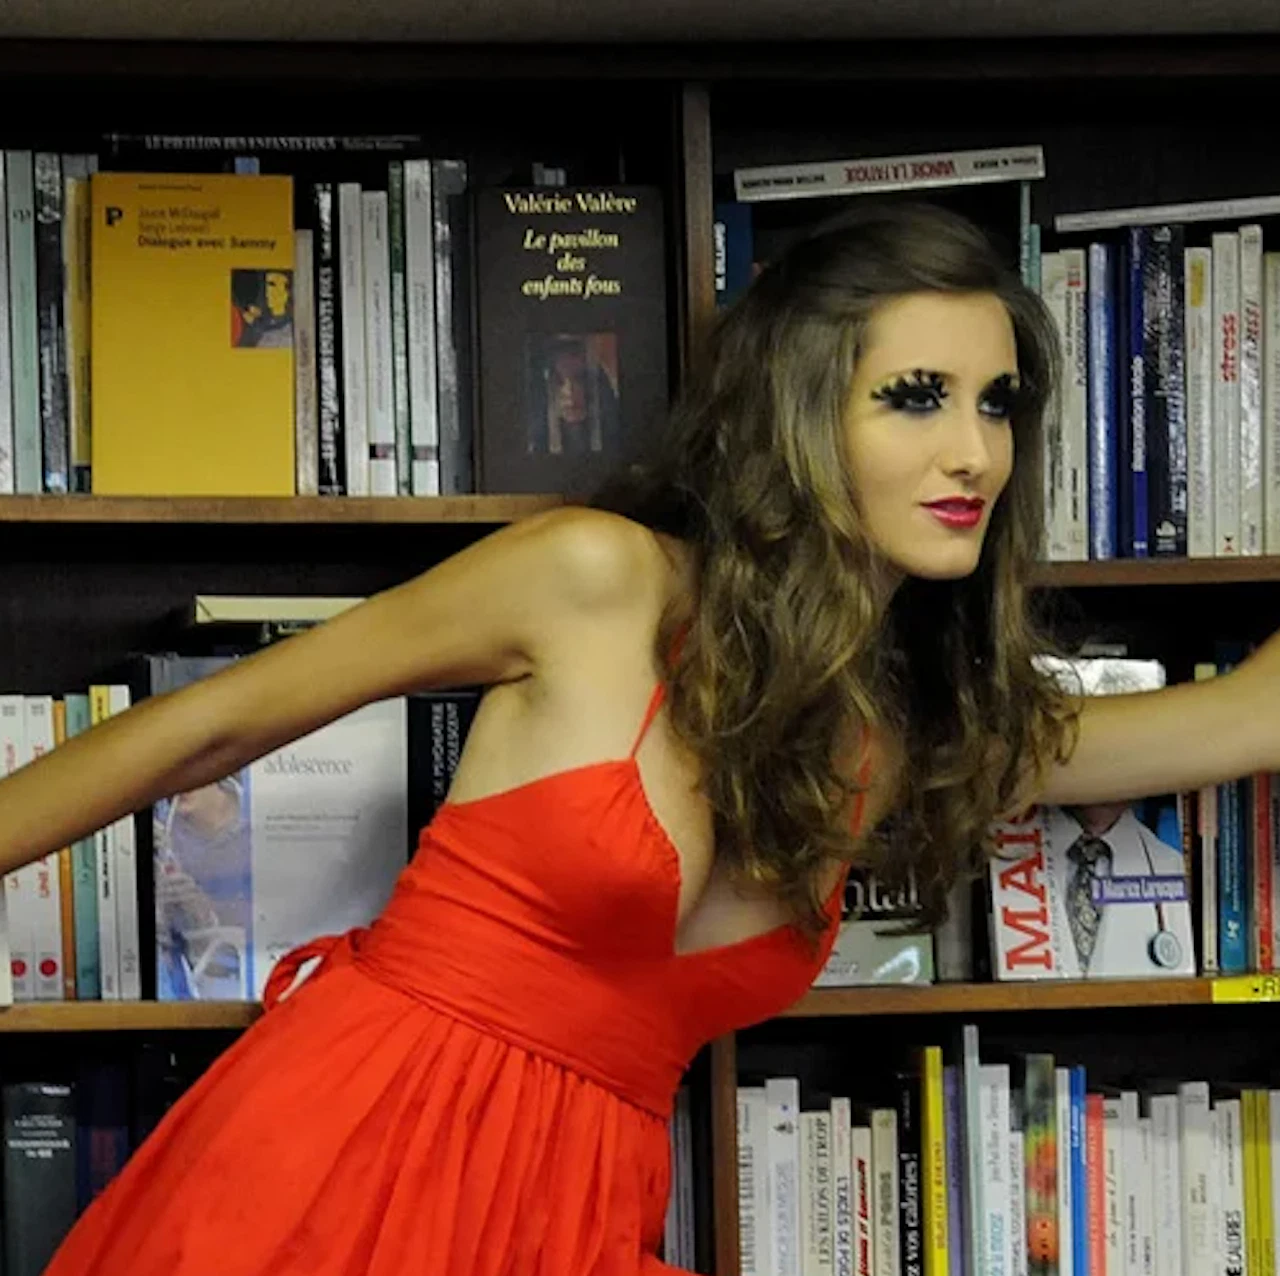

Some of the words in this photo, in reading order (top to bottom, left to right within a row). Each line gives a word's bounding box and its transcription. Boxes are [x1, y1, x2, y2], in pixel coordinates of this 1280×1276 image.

[505, 192, 574, 214] Valérie
[575, 191, 638, 214] Valère
[105, 206, 124, 227] P
[137, 235, 193, 252] Dialogue
[194, 238, 225, 250] avec
[523, 229, 545, 250] Le
[547, 230, 620, 254] pavillon
[555, 251, 587, 271] des
[521, 276, 580, 299] enfants
[581, 276, 623, 299] fous
[1219, 313, 1238, 381] stress
[1131, 399, 1146, 471] Relaxation
[263, 753, 352, 776] adolescence
[816, 1117, 830, 1158] TROP
[816, 1164, 830, 1183] DE
[899, 1152, 920, 1228] calories!
[816, 1187, 830, 1233] KILOS
[816, 1236, 830, 1265] LES
[899, 1231, 920, 1261] vos
